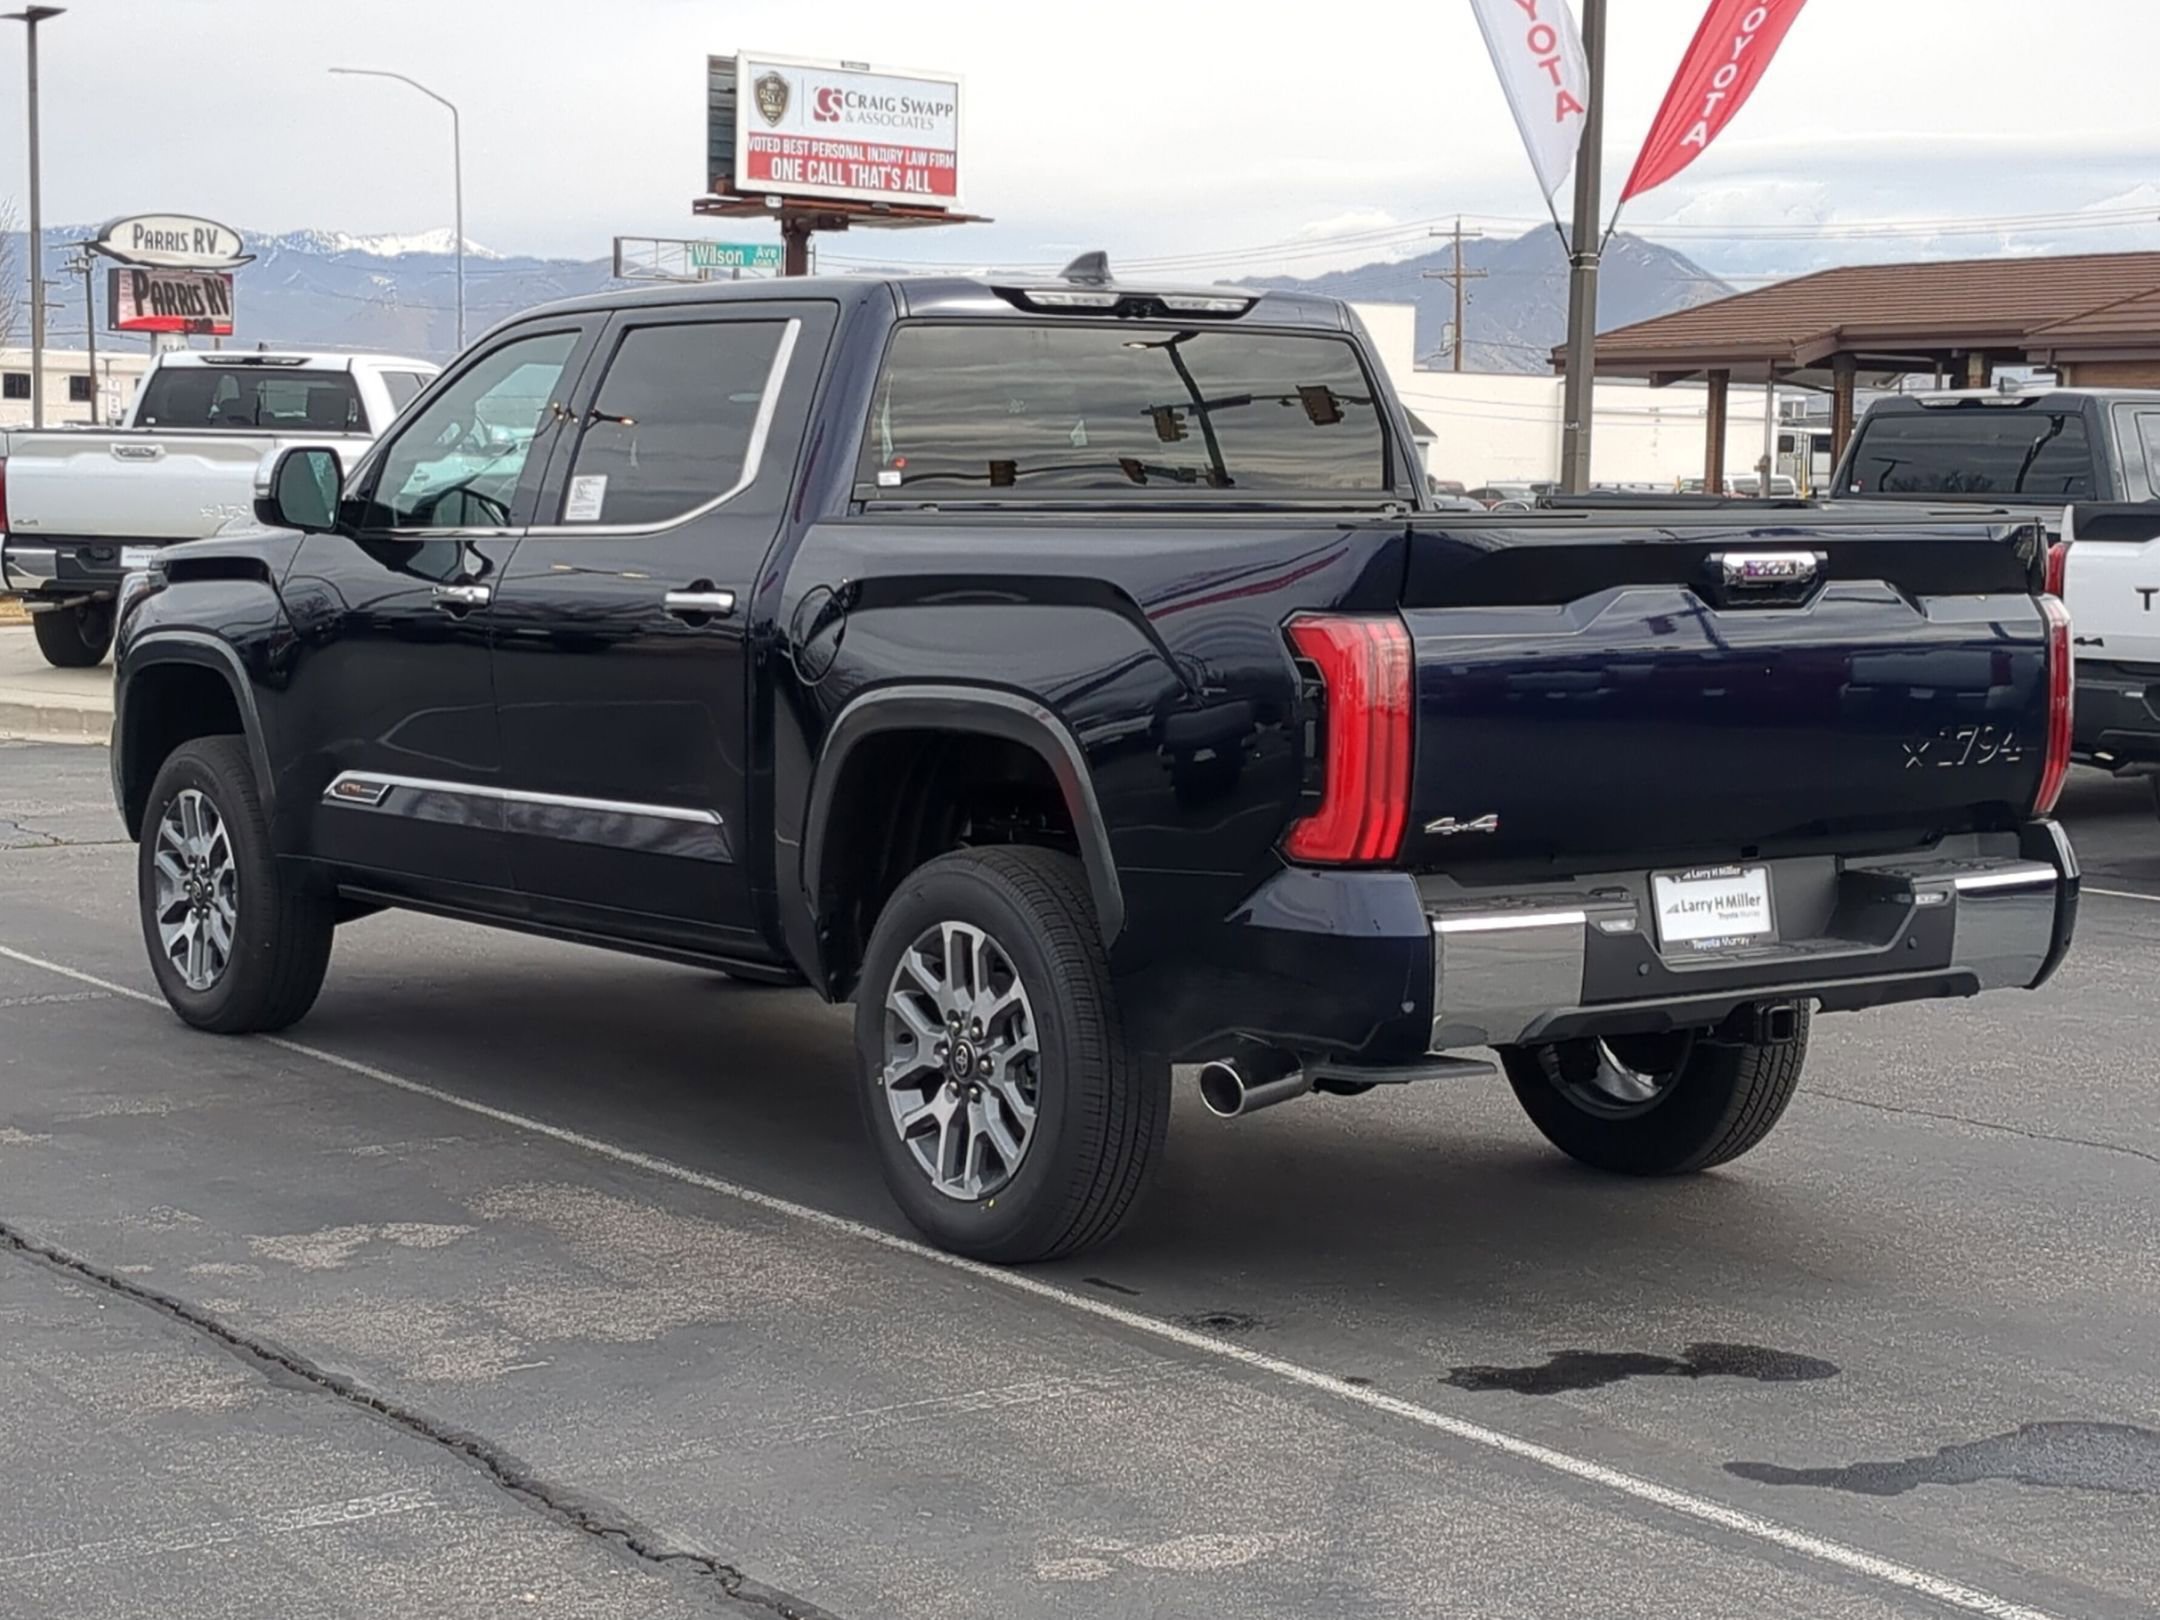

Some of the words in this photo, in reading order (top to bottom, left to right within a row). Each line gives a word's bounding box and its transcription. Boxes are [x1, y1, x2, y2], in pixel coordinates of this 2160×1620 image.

[1681, 0, 1770, 148] OYOTA
[844, 90, 896, 113] CRAIG
[900, 97, 954, 118] SWAPP
[845, 111, 854, 123] &
[857, 112, 934, 131] ASSOCIATES
[748, 134, 781, 152] VOTED
[783, 138, 809, 155] BEST
[812, 142, 865, 161] PERSONAL
[867, 146, 904, 165] INJURY
[905, 150, 928, 166] LAW
[928, 153, 955, 170] FIRM
[771, 156, 803, 182] ONE
[807, 160, 846, 186] CALL
[849, 163, 901, 190] THAT'S
[904, 169, 932, 193] ALL
[133, 223, 189, 252] PARRIS
[193, 227, 218, 255] RV
[694, 244, 744, 265] Wilson
[755, 245, 777, 259] Ave
[131, 270, 206, 317] PARRIS
[202, 277, 230, 317] RV
[1936, 725, 2022, 767] 1794
[1691, 868, 1711, 879] Larry
[1719, 866, 1742, 876] Miller
[1681, 899, 1712, 913] Larry
[1714, 896, 1724, 909] H
[1726, 892, 1761, 907] Miller
[1691, 938, 1721, 950] Toyota
